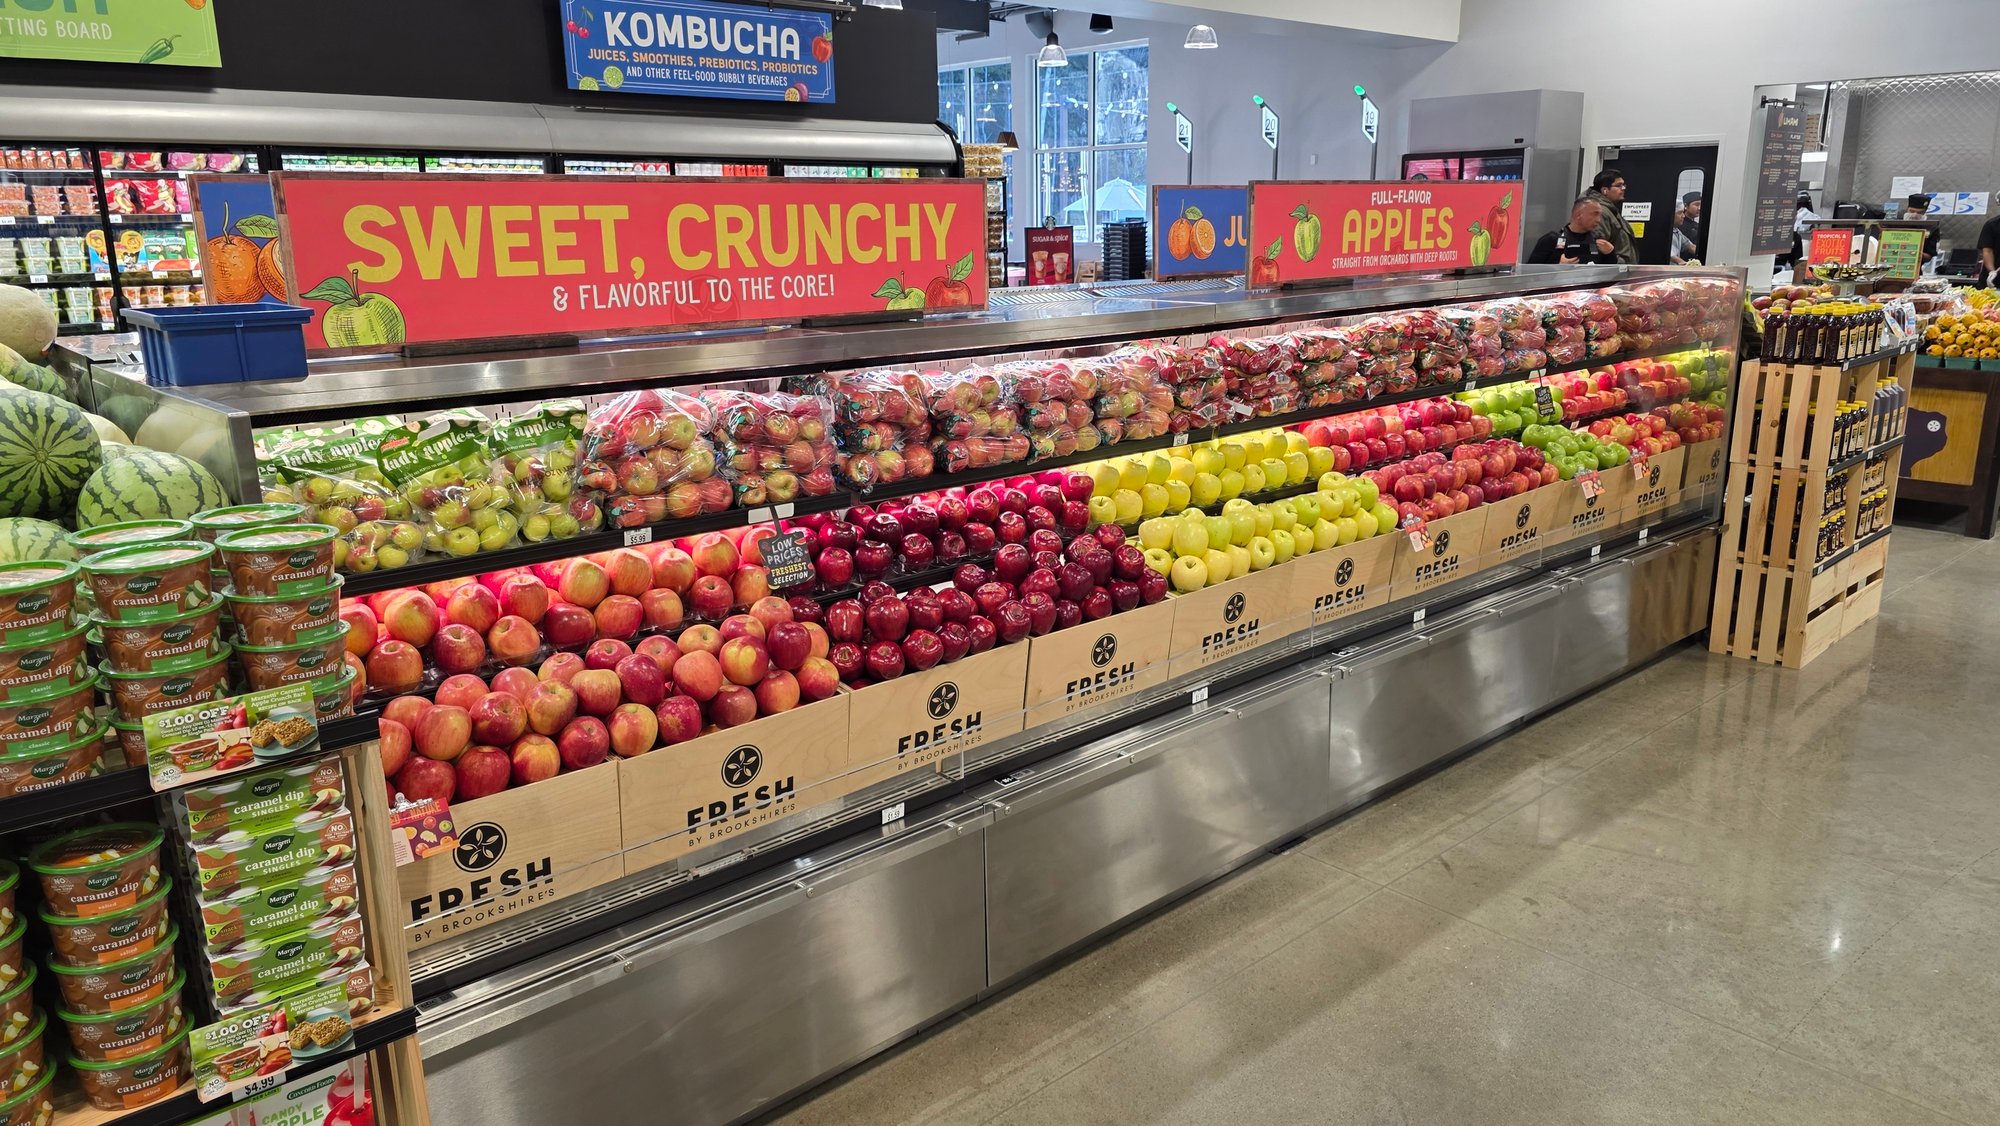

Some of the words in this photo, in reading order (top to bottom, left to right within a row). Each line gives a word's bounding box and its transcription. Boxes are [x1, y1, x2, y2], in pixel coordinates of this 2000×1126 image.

[0, 17, 48, 37] TING
[56, 21, 112, 40] BOARD
[603, 12, 800, 60] KOMBUCHA
[587, 48, 629, 63] JUICES,
[633, 52, 696, 67] SMOOTHIES,
[699, 57, 759, 71] PREBIOTICS,
[762, 61, 818, 75] PROBIOTICS
[627, 66, 643, 77] AND
[645, 67, 671, 79] OTHER
[673, 69, 716, 82] FEEL-GOOD
[719, 72, 745, 84] BUBBLY
[748, 74, 788, 87] BEVERAGES
[1265, 118, 1275, 131] 20
[1365, 111, 1375, 124] 19
[1179, 123, 1189, 136] 21
[1371, 190, 1432, 206] FULL-FLAVOR
[1224, 215, 1247, 248] JU
[1342, 207, 1454, 254] APPLES
[343, 204, 645, 283] SWEET,
[667, 202, 957, 271] CRUNCHY
[1816, 239, 1845, 248] EXOTIC
[1332, 256, 1361, 269] STRAIGHT
[1363, 255, 1379, 267] FROM
[1380, 253, 1409, 266] ORCHARDS
[1410, 252, 1423, 263] WITH
[1424, 251, 1438, 263] DEEP
[553, 286, 568, 311] &
[579, 279, 700, 310] FLAVORFUL
[707, 278, 732, 302] TO
[738, 276, 774, 300] THE
[781, 274, 835, 297] CORE!
[515, 419, 565, 438] apples
[281, 449, 324, 468] lady
[383, 450, 419, 472] lady
[422, 431, 475, 456] apples
[630, 535, 646, 545] $5.99
[771, 537, 793, 553] LOW
[767, 546, 803, 565] PRICES
[271, 568, 315, 582] caramel
[316, 564, 329, 576] dip
[771, 562, 807, 577] FRESHEST
[773, 571, 809, 585] SELECTION
[1415, 554, 1459, 582] FRESH
[113, 593, 159, 606] caramel
[162, 592, 181, 602] dip
[1314, 584, 1365, 614] FRESH
[0, 612, 49, 630] caramel
[52, 609, 67, 619] dip
[275, 606, 289, 614] NO
[291, 616, 330, 631] caramel
[126, 632, 140, 640] NO
[1202, 618, 1260, 655] FRESH
[145, 642, 192, 658] caramel
[195, 638, 209, 648] dip
[0, 670, 52, 686] caramel
[55, 664, 72, 677] dip
[281, 666, 324, 681] caramel
[326, 662, 338, 673] dip
[1066, 661, 1135, 701] FRESH
[146, 695, 193, 710] caramel
[195, 691, 211, 702] dip
[1066, 702, 1075, 712] BY
[1078, 683, 1135, 708] BROOKSHIRE'S
[159, 713, 194, 728] $1.00
[199, 706, 229, 720] OFF
[0, 727, 51, 741] caramel
[54, 721, 73, 733] dip
[898, 711, 982, 759] FRESH
[898, 761, 909, 771] BY
[914, 734, 982, 765] BROOKSHRE'S
[15, 777, 66, 793] caramel
[69, 771, 86, 783] dip
[163, 768, 175, 776] NO
[234, 797, 282, 815] caramel
[285, 790, 304, 803] dip
[251, 803, 290, 818] SINGLES
[687, 775, 796, 835] FRESH
[192, 814, 200, 823] 6
[331, 824, 343, 832] NO
[689, 836, 702, 847] BY
[709, 802, 796, 840] BROOKSHIRE'S
[245, 853, 293, 872] caramel
[296, 847, 315, 860] dip
[262, 860, 301, 875] SINGLES
[204, 871, 211, 880] 6
[334, 876, 347, 884] NO
[71, 888, 118, 903] caramel
[122, 882, 139, 893] dip
[412, 856, 554, 927] FRESH
[250, 907, 298, 926] caramel
[300, 900, 319, 913] dip
[267, 913, 305, 928] SINGLES
[414, 929, 433, 943] BY
[443, 888, 556, 935] BROOKSHIRE'S
[92, 934, 139, 952] caramel
[142, 925, 157, 938] dip
[209, 927, 217, 936] 6
[342, 928, 354, 936] NO
[257, 959, 305, 979] caramel
[307, 951, 326, 964] dip
[274, 964, 312, 981] SINGLES
[104, 982, 150, 1000] caramel
[152, 972, 166, 985] dip
[218, 980, 225, 989] 6
[351, 978, 363, 986] NO
[205, 1024, 239, 1040] $1.00
[242, 1012, 271, 1029] OFF
[99, 1033, 146, 1049] caramel
[148, 1024, 164, 1036] dip
[117, 1077, 163, 1094] caramel
[165, 1066, 179, 1078] dip
[245, 1076, 275, 1096] $4.99
[288, 1085, 317, 1099] CONCORD
[262, 1102, 304, 1125] CANDY
